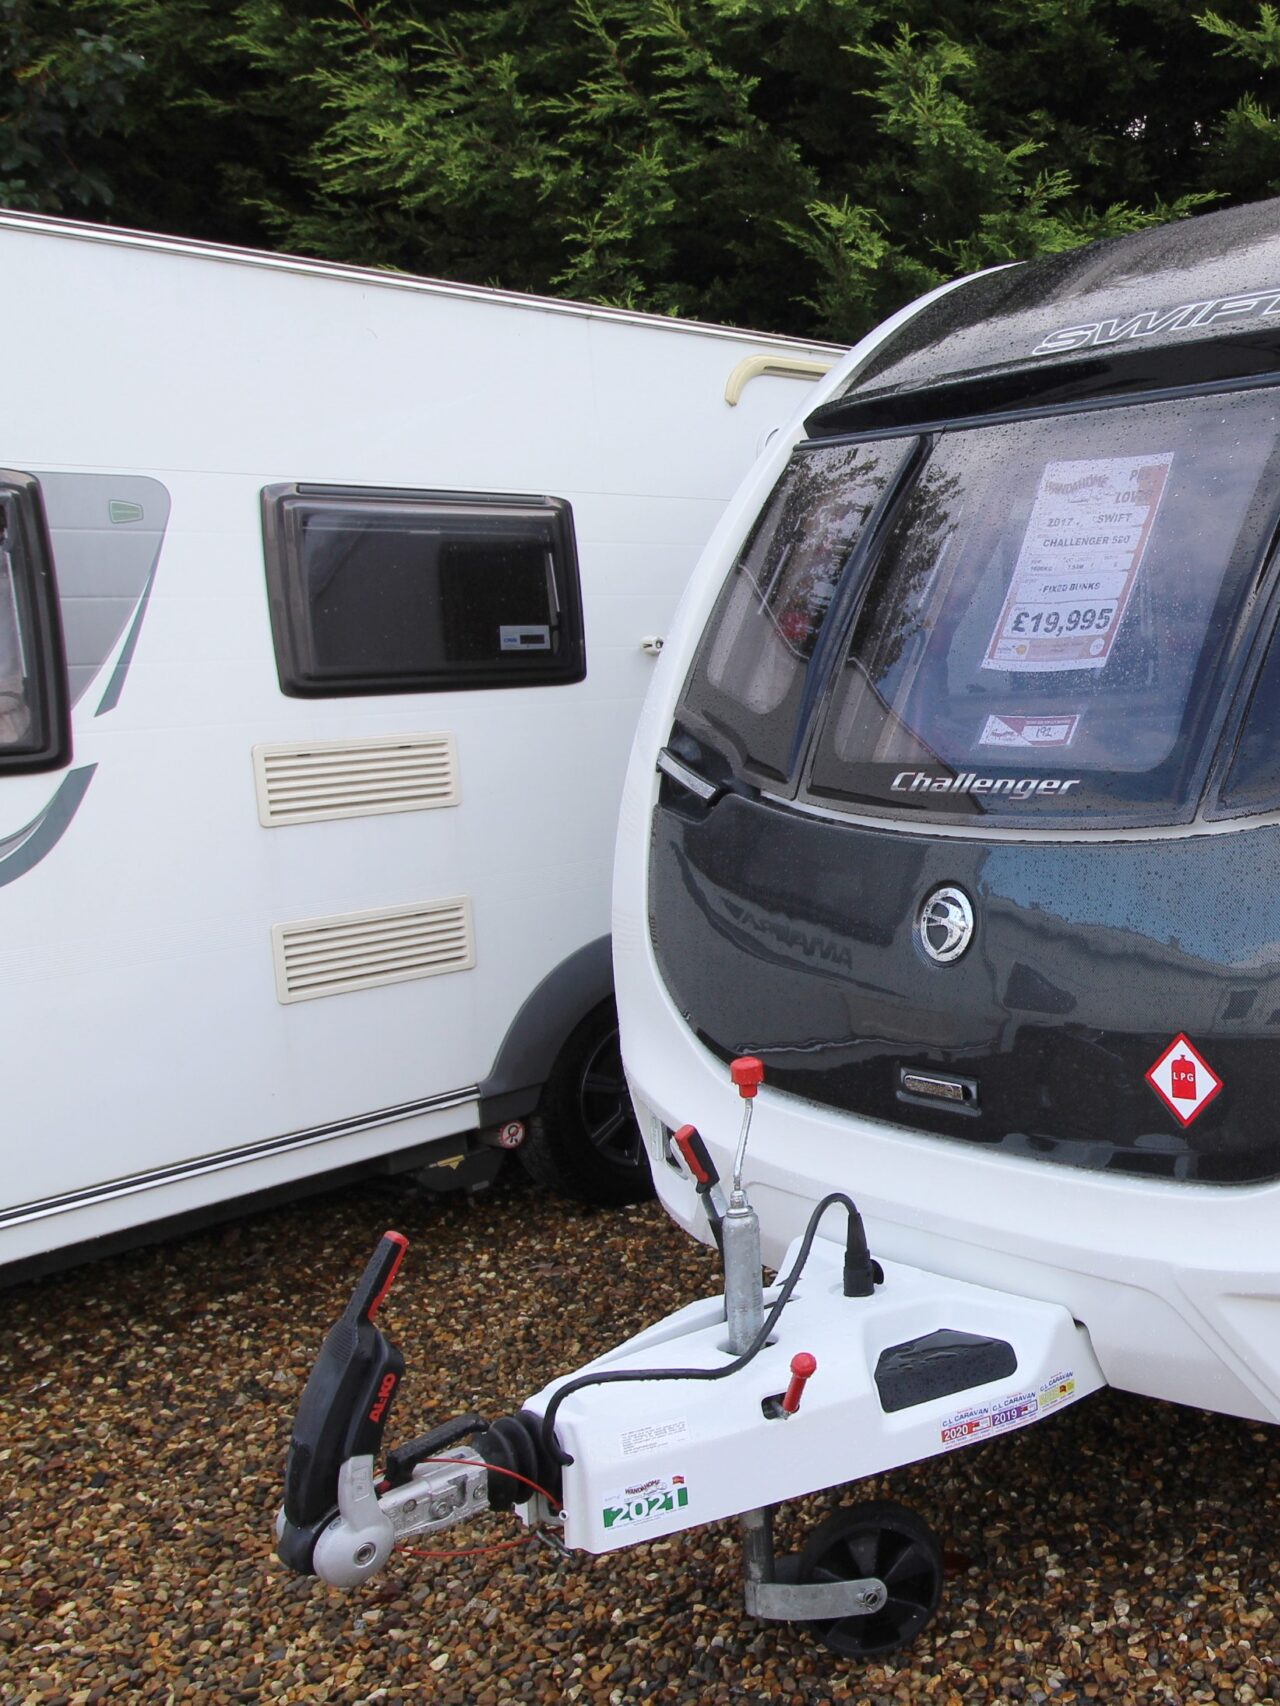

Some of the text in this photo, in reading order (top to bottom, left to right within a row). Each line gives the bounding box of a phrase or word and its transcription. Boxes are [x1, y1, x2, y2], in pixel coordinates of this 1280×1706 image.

[1097, 512, 1133, 524] SWIFT
[1042, 536, 1110, 548] CHALLENGER
[1011, 608, 1113, 637] £19,995
[890, 772, 1081, 800] Challenger
[1173, 1071, 1195, 1082] LPG
[1004, 1391, 1037, 1407] CARAVAN
[954, 1407, 989, 1422] CARAVAN
[993, 1408, 1018, 1425] 2019
[944, 1424, 969, 1441] 2020
[610, 1489, 680, 1528] 2021
